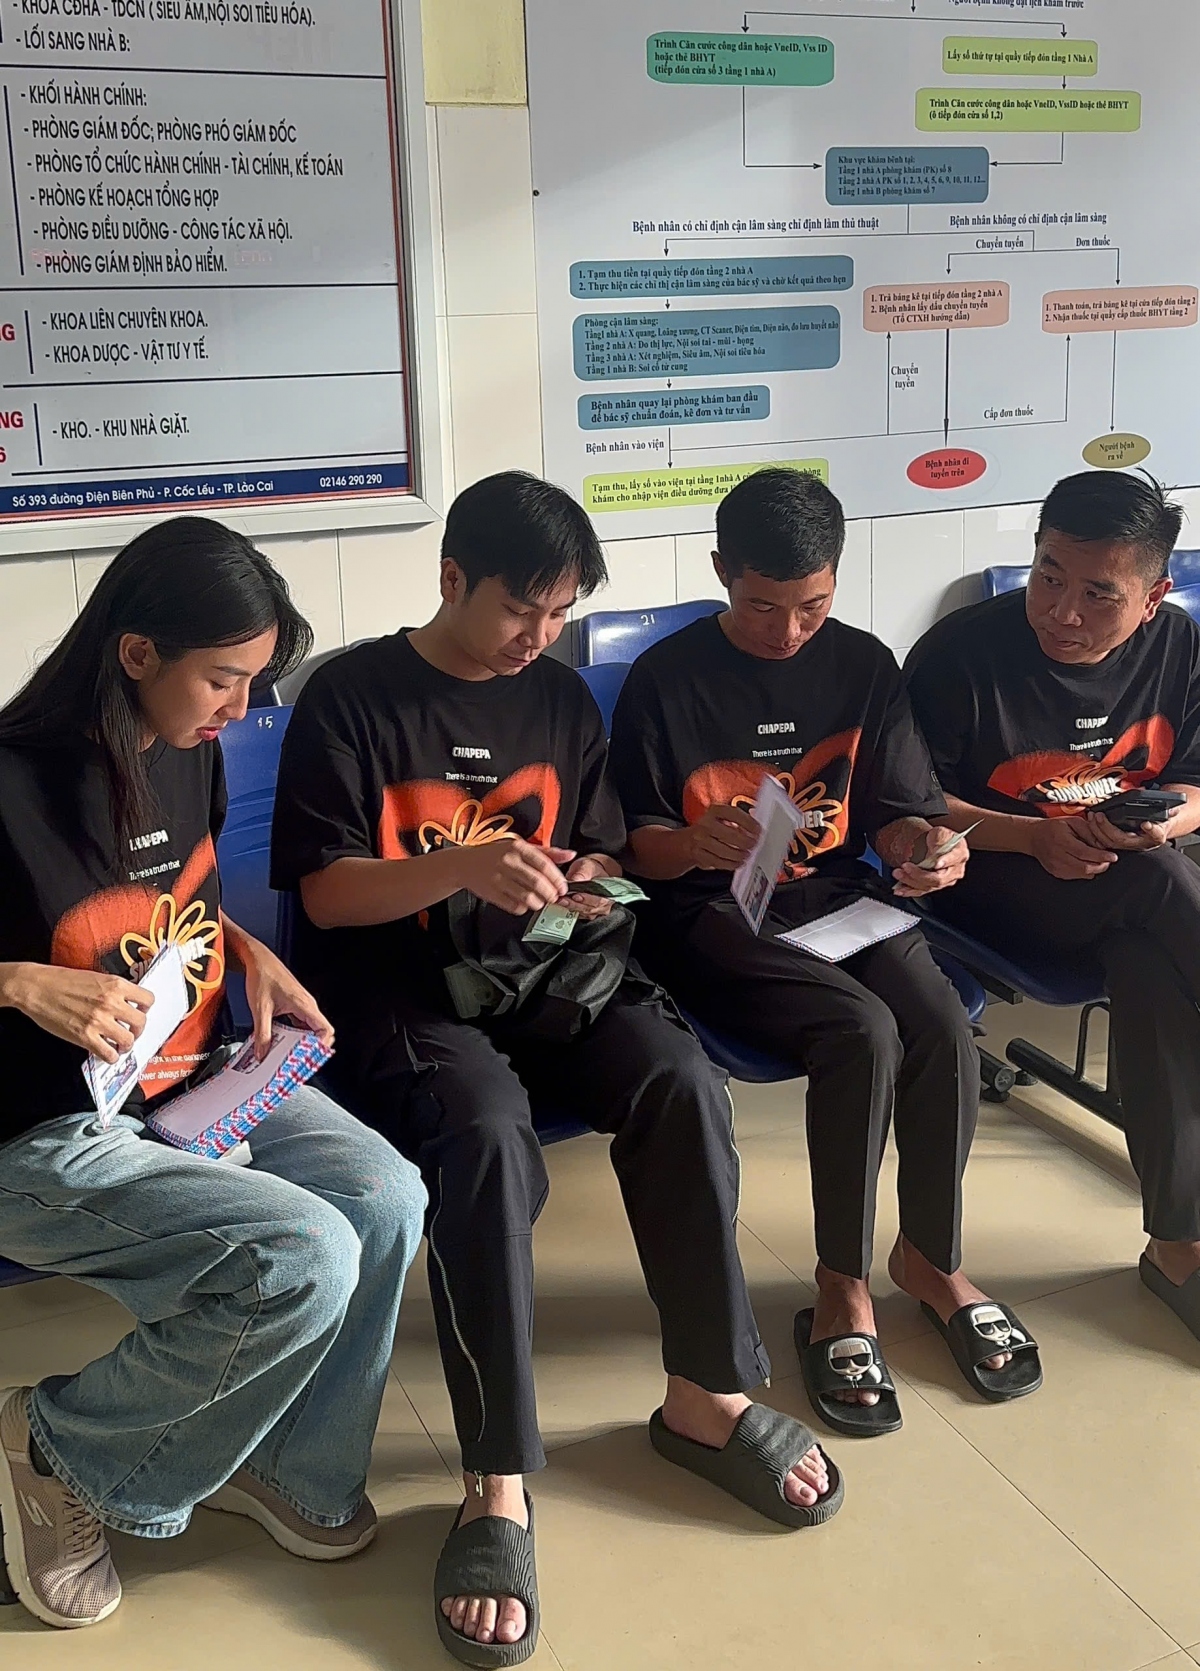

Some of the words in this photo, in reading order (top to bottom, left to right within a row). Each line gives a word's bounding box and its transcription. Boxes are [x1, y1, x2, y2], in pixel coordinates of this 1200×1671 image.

[234, 4, 253, 22] SOI
[256, 1, 277, 23] TIÊU
[24, 23, 45, 48] LỐI
[48, 31, 84, 50] SANG
[88, 27, 116, 51] NHÀ
[119, 34, 130, 52] B:
[29, 79, 60, 104] KHỐI
[64, 80, 100, 104] HÀNH
[104, 82, 146, 106] CHÍNH:
[32, 114, 79, 139] PHÒNG
[83, 115, 118, 139] GIÁM
[121, 115, 154, 142] ĐỐC;
[158, 117, 201, 140] PHÒNG
[205, 118, 230, 141] PHÓ
[234, 119, 266, 142] GIÁM
[269, 118, 297, 143] ĐỐC
[36, 148, 82, 172] PHÒNG
[85, 146, 101, 172] TỔ
[106, 150, 141, 173] CHỨC
[145, 150, 179, 173] HÀNH
[183, 152, 220, 174] CHÍNH
[232, 152, 249, 174] TÀI
[253, 152, 292, 177] CHÍNH,
[296, 152, 309, 175] KẾ
[312, 153, 343, 175] TOÁN
[39, 183, 85, 206] PHÒNG
[89, 182, 103, 206] KẾ
[108, 189, 151, 210] HOẠCH
[156, 180, 191, 206] TỔNG
[194, 189, 219, 211] HỢP
[42, 216, 88, 240] PHÒNG
[92, 214, 119, 240] ĐIỀU
[123, 218, 169, 240] DƯỠNG
[181, 218, 219, 239] CÔNG
[222, 217, 245, 239] TÁC
[248, 218, 265, 239] XÃ
[269, 219, 292, 243] HỘI.
[633, 221, 655, 234] Bệnh
[658, 221, 680, 232] nhân
[683, 220, 692, 231] có
[710, 220, 729, 234] định
[732, 219, 747, 233] cận
[749, 219, 764, 231] lâm
[766, 219, 786, 232] sàng
[803, 218, 821, 231] định
[950, 215, 969, 228] Bệnh
[972, 215, 990, 225] nhân
[993, 214, 1016, 227] không
[46, 251, 91, 273] PHÒNG
[96, 250, 129, 272] GIÁM
[133, 251, 163, 276] ĐỊNH
[167, 248, 192, 272] BẢO
[196, 246, 227, 272] HIỂM.
[51, 313, 87, 330] KHOA
[91, 308, 114, 329] LIÊN
[119, 307, 166, 328] CHUYÊN
[171, 311, 208, 328] KHOA.
[54, 346, 90, 363] KHOA
[94, 344, 129, 365] DƯỢC
[141, 340, 164, 364] VẬT
[167, 342, 180, 360] TƯ
[183, 343, 190, 359] Y
[194, 335, 208, 359] TẾ.
[616, 399, 636, 410] nhân
[701, 395, 724, 404] khám
[726, 394, 741, 402] ban
[61, 422, 91, 439] KHO.
[104, 420, 126, 437] KHU
[131, 413, 157, 435] NHÀ
[604, 412, 618, 422] bác
[586, 443, 606, 455] Bệnh
[609, 442, 629, 452] nhân
[631, 440, 646, 450] vào
[648, 439, 664, 450] viện
[13, 494, 26, 507] Số
[28, 495, 47, 506] 393
[50, 492, 83, 505] đường
[86, 490, 110, 504] Điện
[113, 489, 133, 501] Biên
[136, 486, 154, 499] Phủ
[164, 487, 171, 497] P.
[174, 485, 194, 496] Cốc
[197, 484, 214, 495] Lếu
[223, 483, 235, 494] TP.
[238, 482, 254, 493] Lào
[257, 481, 273, 491] Cai
[320, 476, 346, 487] 02146
[349, 475, 364, 485] 290
[367, 474, 382, 484] 290
[592, 483, 610, 494] Tạm
[640, 614, 656, 626] 21
[258, 716, 273, 728] 15
[757, 722, 795, 734] CHAPEPA
[452, 746, 491, 759] CHAPEPA
